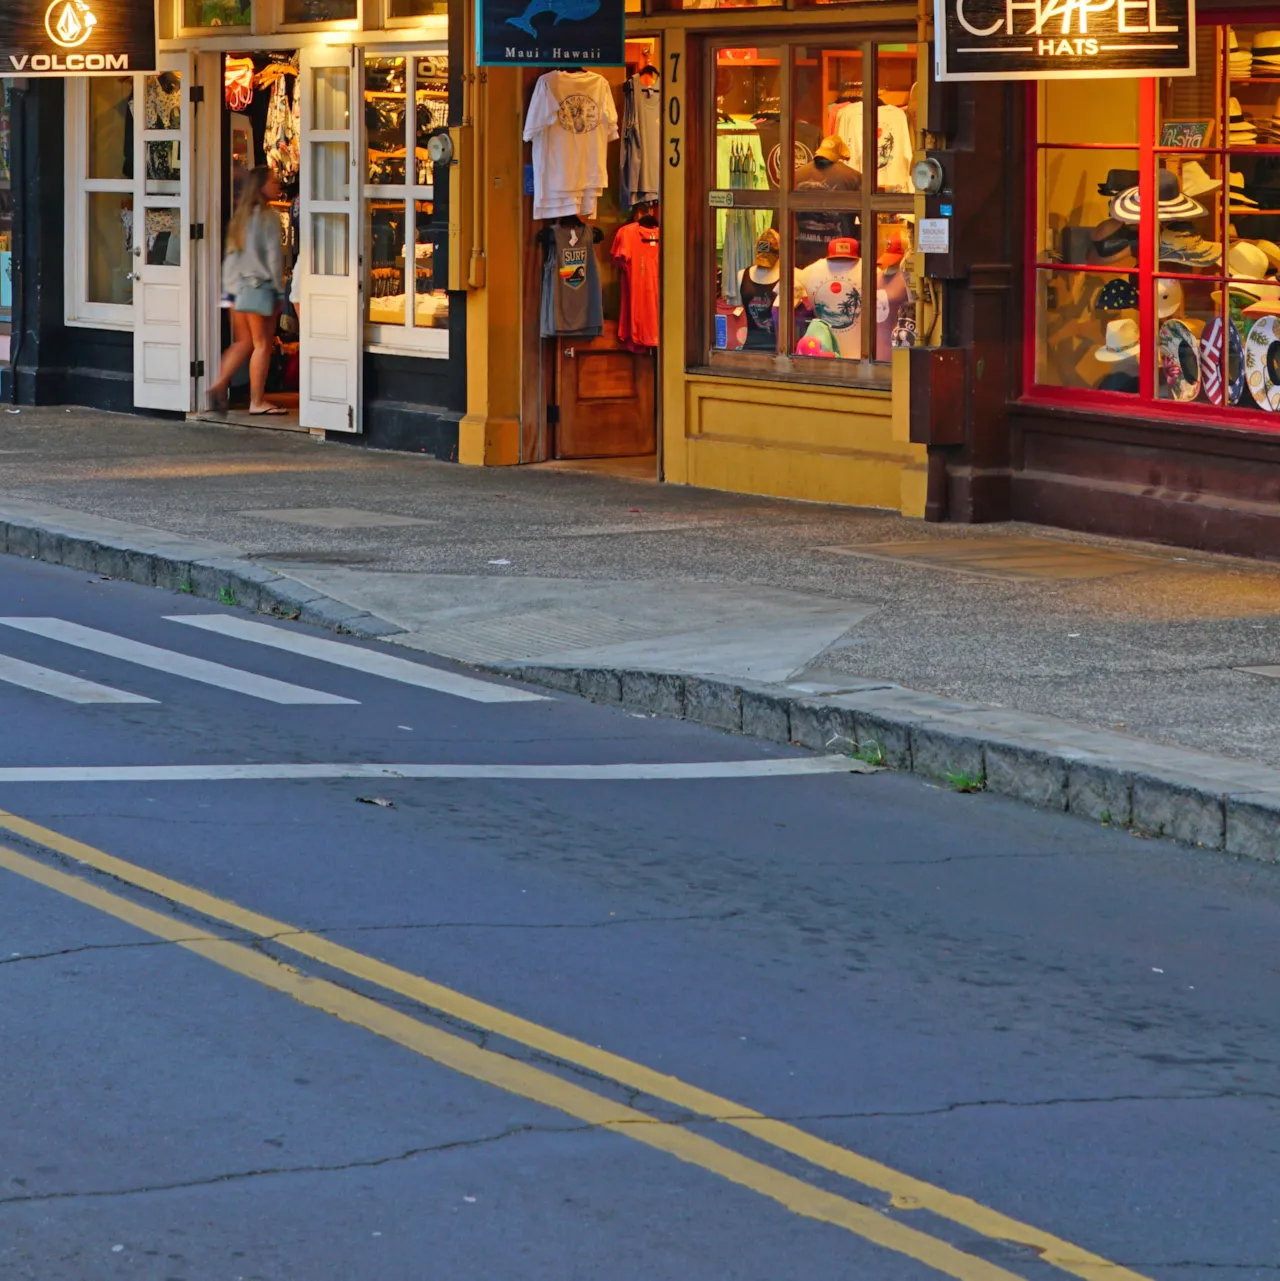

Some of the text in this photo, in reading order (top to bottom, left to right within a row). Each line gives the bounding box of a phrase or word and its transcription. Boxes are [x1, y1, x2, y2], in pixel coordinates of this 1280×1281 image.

[505, 47, 601, 59] Maui Hawaii
[1037, 38, 1099, 56] HATS
[9, 54, 129, 70] VOLCOM
[669, 53, 680, 167] 703
[565, 250, 585, 261] SURF
